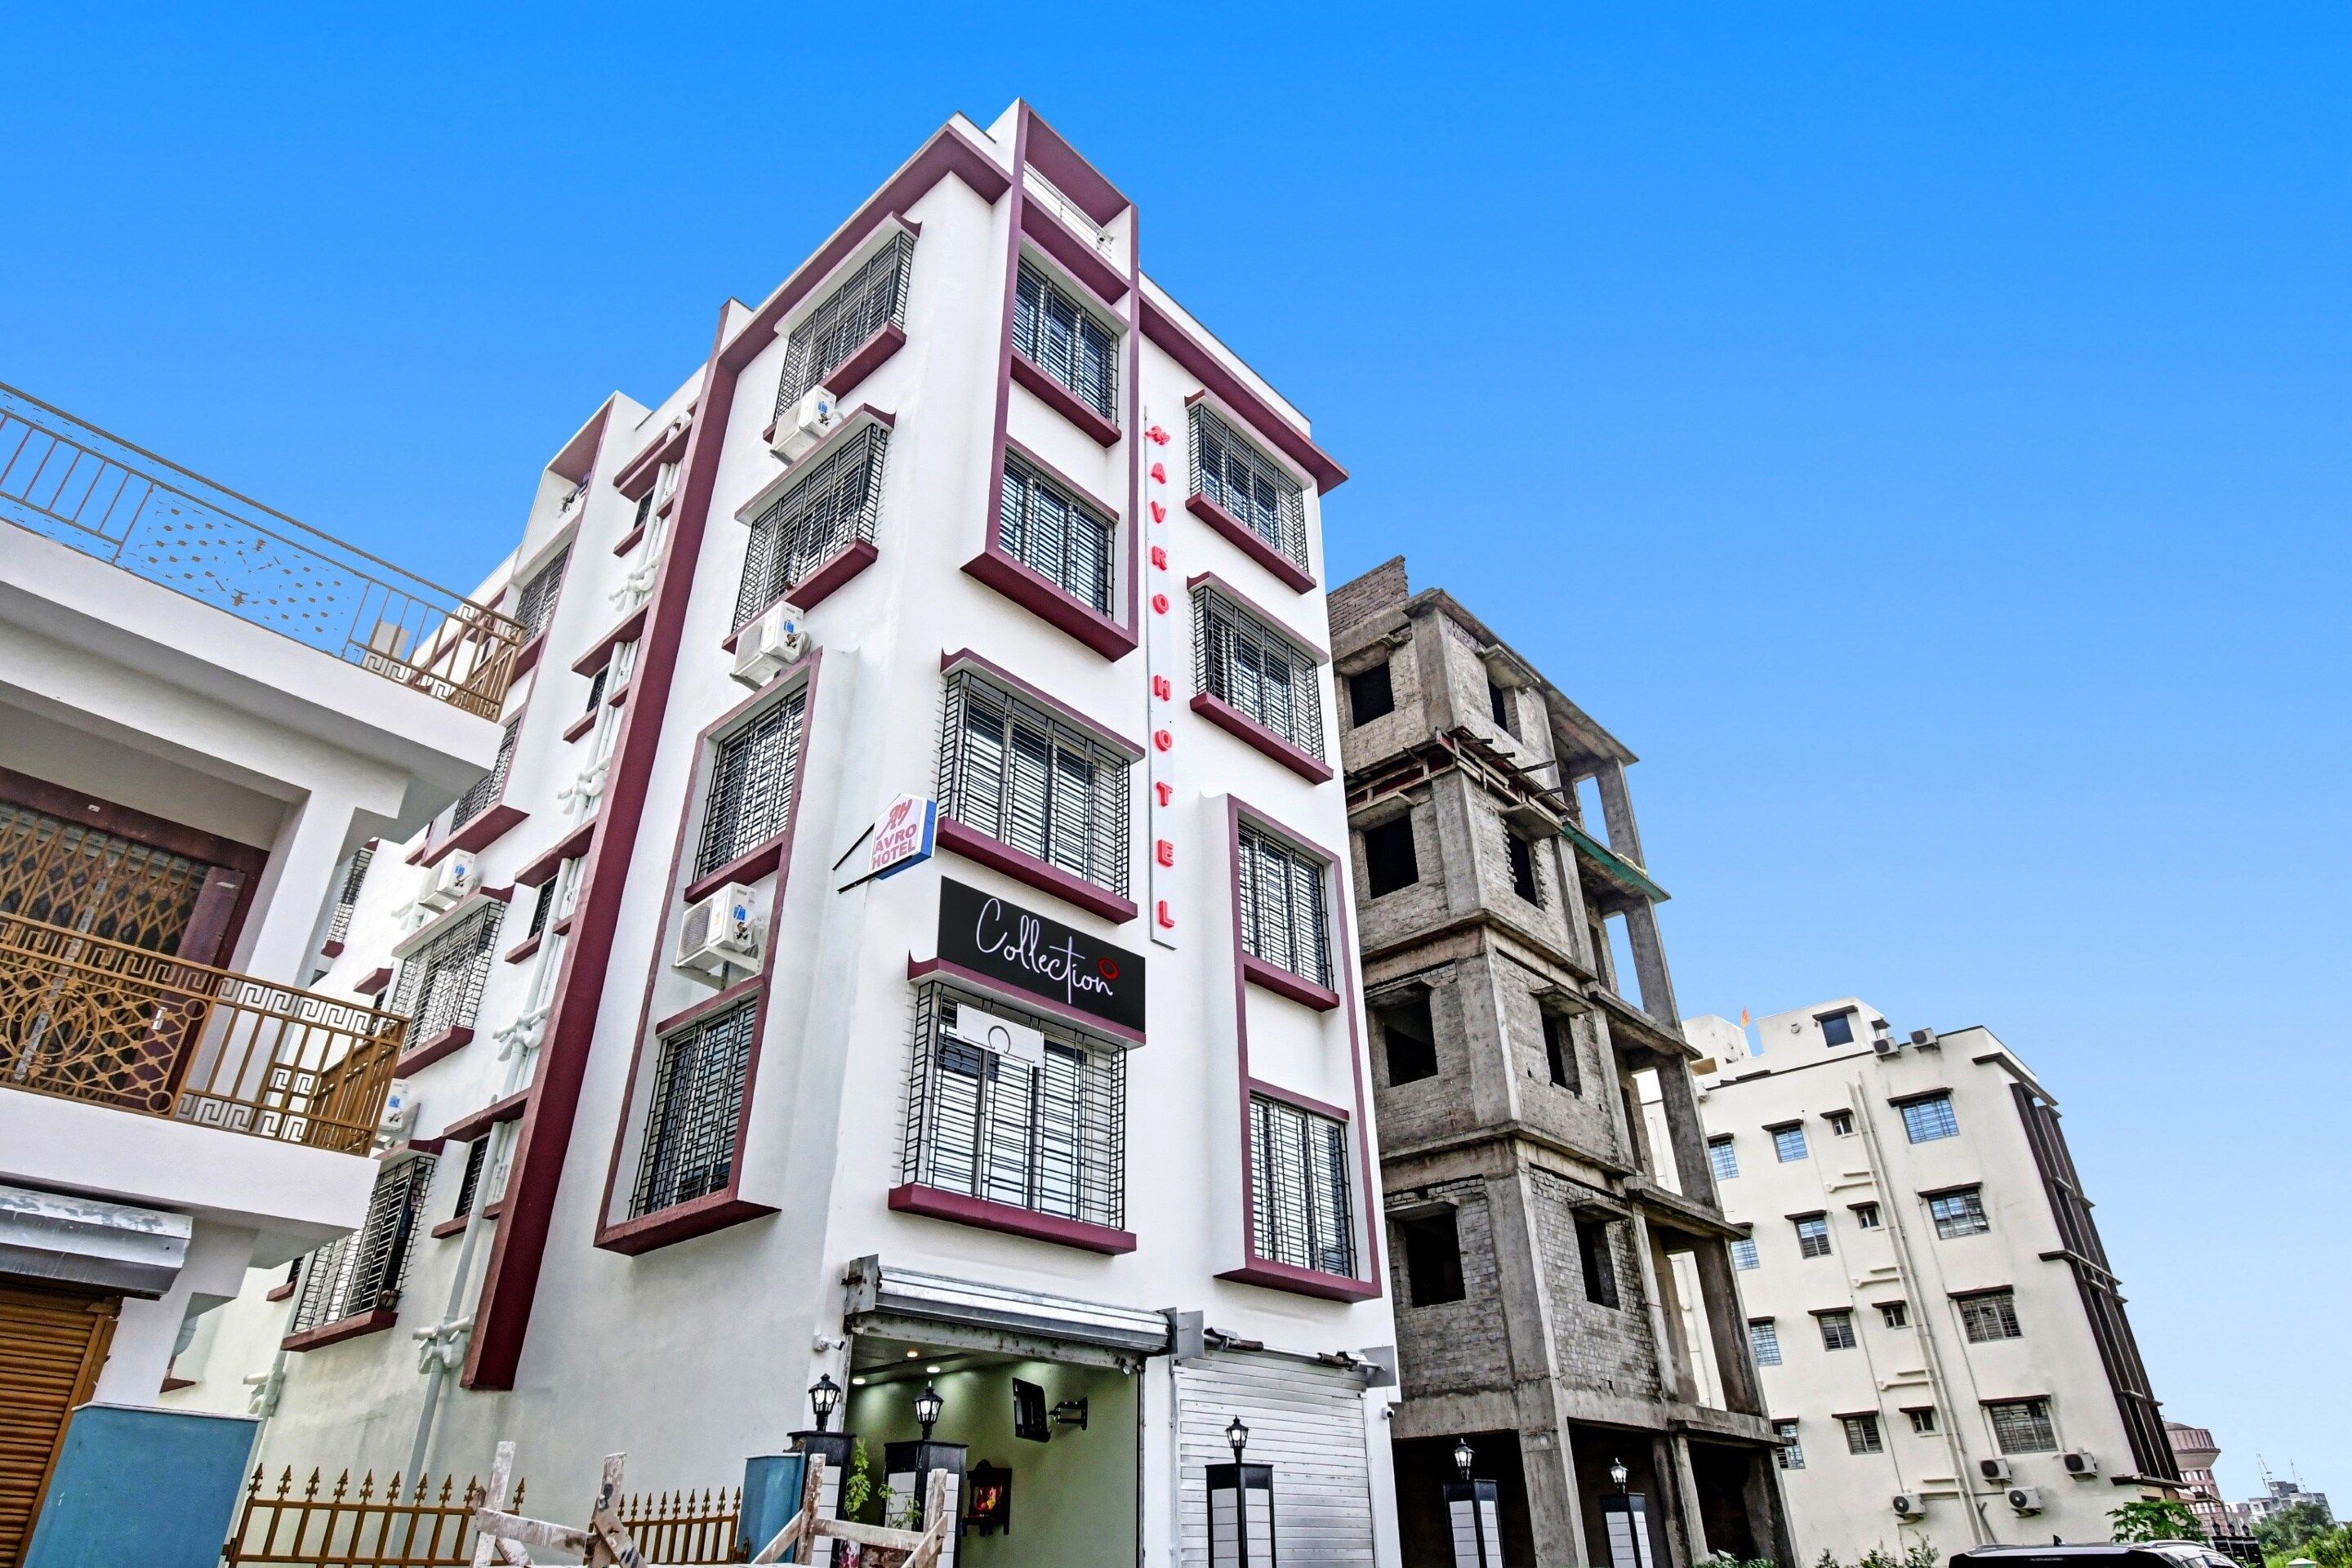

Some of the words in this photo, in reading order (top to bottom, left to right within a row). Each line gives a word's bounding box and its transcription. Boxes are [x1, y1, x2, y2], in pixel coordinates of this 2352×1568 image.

[1149, 461, 1169, 616] AVRO
[871, 839, 915, 871] HOTEL
[875, 823, 917, 854] AVRO
[1152, 675, 1174, 929] HOTEL
[975, 898, 1114, 1004] Collection
